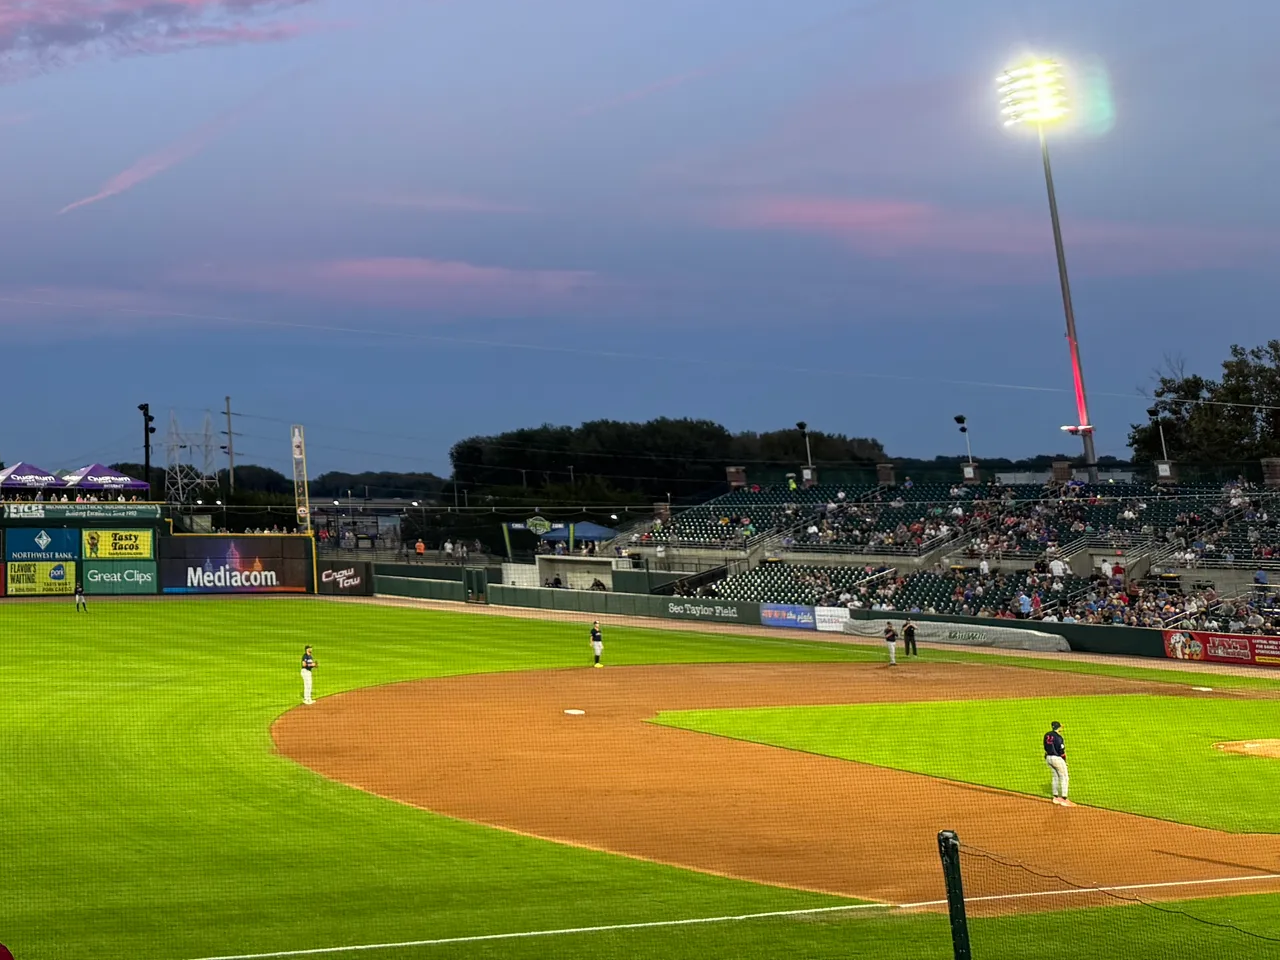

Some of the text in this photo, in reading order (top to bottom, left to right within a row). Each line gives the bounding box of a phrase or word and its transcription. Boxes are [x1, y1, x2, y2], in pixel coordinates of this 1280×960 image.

[111, 533, 139, 542] Tasty
[111, 542, 139, 550] Tacos
[10, 563, 36, 573] FLAVOR'S
[51, 568, 64, 577] pork
[88, 570, 151, 584] Great Clips
[187, 564, 277, 587] Mediacom
[322, 568, 354, 582] Crow
[337, 576, 361, 588] Tow
[668, 603, 738, 617] Sec Taylor Field
